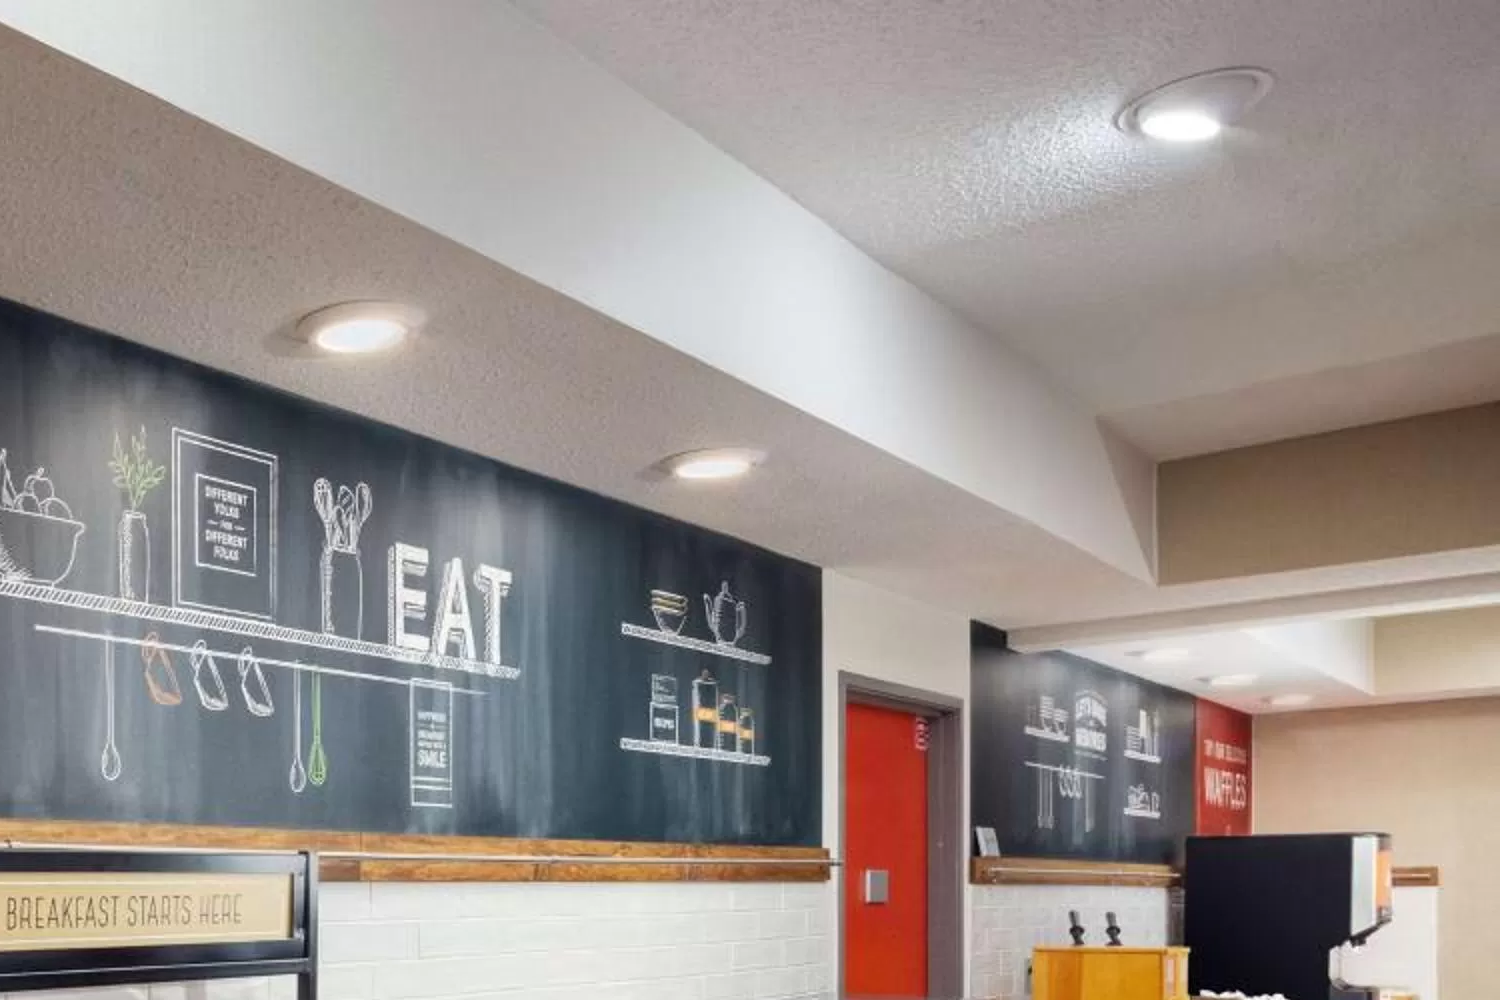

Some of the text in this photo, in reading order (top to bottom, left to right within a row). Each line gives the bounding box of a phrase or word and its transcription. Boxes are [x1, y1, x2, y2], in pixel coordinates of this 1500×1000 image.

[387, 541, 513, 665] EAT
[1203, 766, 1247, 810] WAFFLES
[6, 895, 119, 931] BREAKFAST
[127, 894, 192, 928] STARTS
[199, 893, 244, 925] HERE
